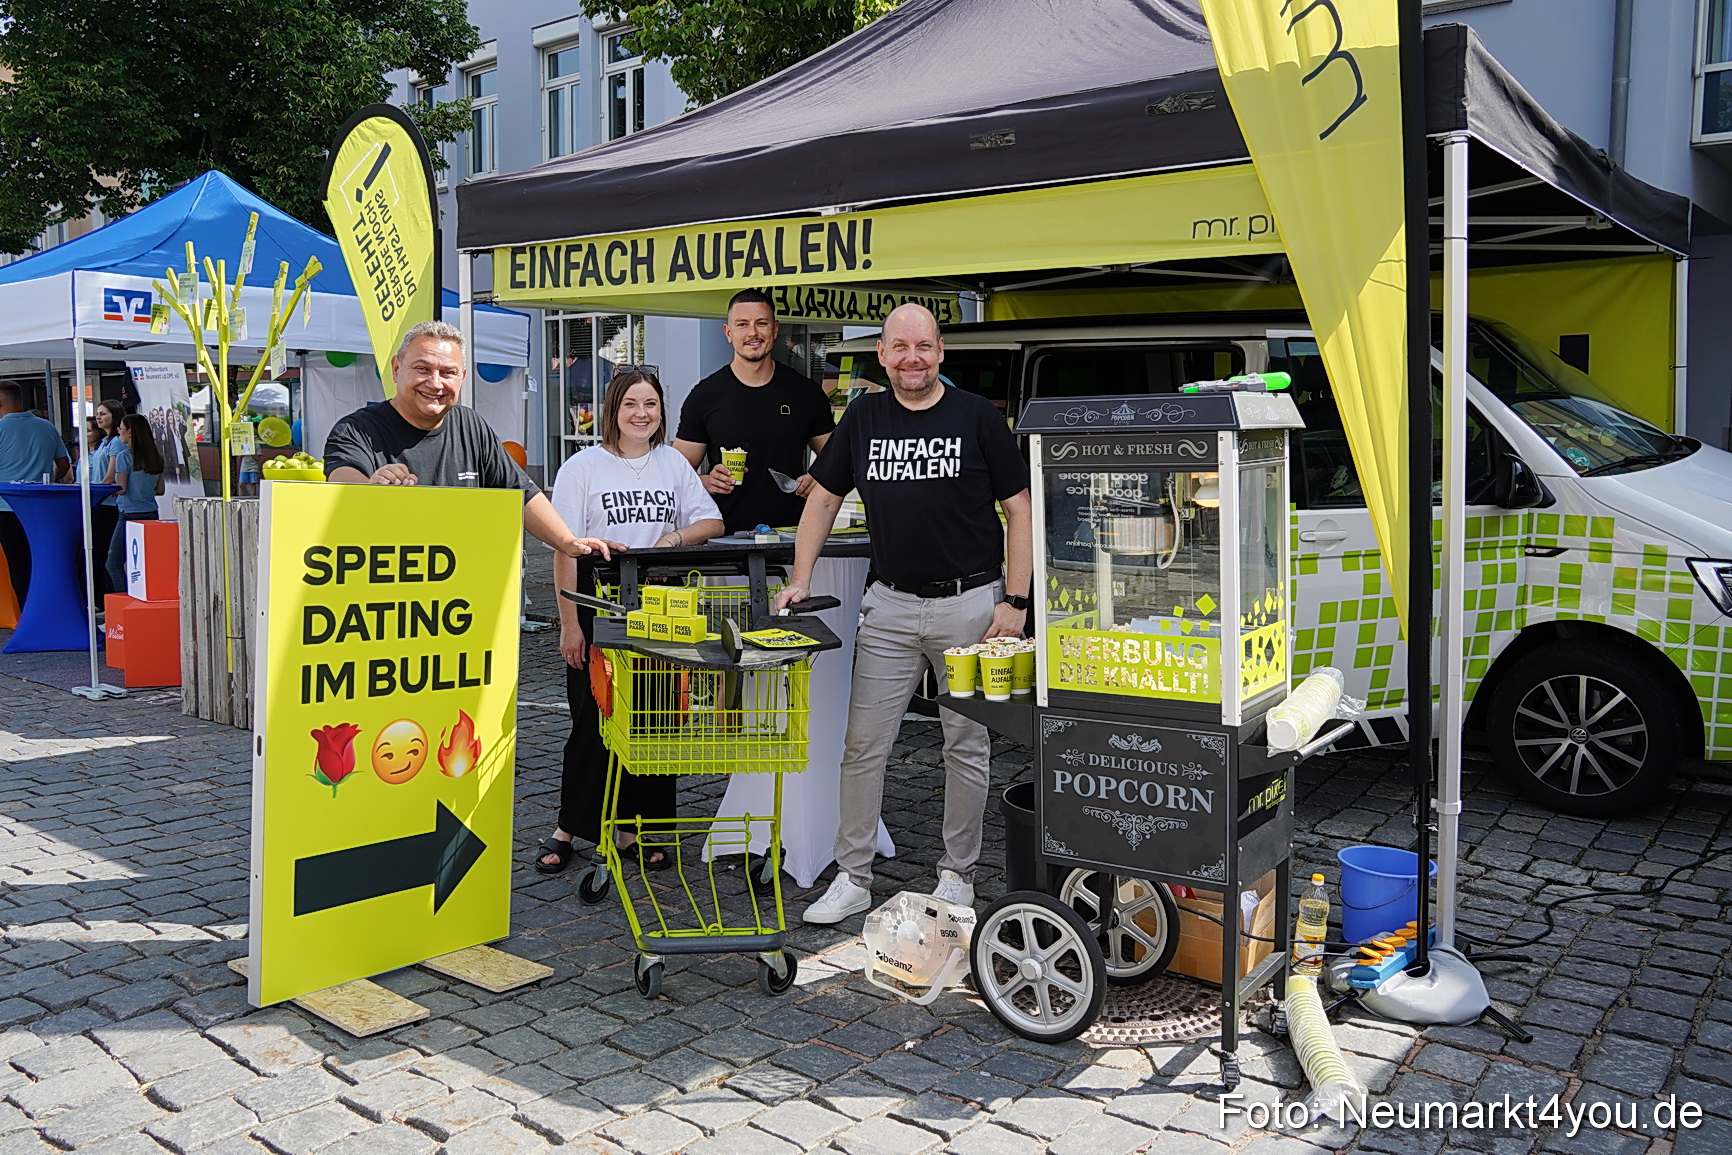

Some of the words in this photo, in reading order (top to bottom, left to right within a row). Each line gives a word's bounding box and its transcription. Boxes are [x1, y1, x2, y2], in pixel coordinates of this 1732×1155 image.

[1192, 216, 1241, 239] mr.
[1248, 214, 1275, 242] pi
[509, 238, 655, 290] EINFACH
[667, 218, 873, 283] AUFALEN!
[869, 437, 962, 460] EINFACH
[1081, 445, 1111, 456] HOT
[1114, 444, 1125, 456] &
[1127, 443, 1174, 456] FRESH
[866, 458, 961, 481] AUFALEN!
[601, 490, 676, 510] EINFACH
[607, 507, 676, 526] AUFALEN!
[302, 545, 456, 586] SPEED
[302, 598, 473, 645] DATING
[652, 622, 667, 630] PIXEL
[675, 624, 691, 632] PIXEL
[1059, 634, 1208, 669] WERBUNG
[301, 661, 355, 704] IM
[368, 650, 492, 697] BULLI
[1059, 662, 1098, 686] DIE
[1103, 666, 1209, 695] KNALLT!
[1088, 753, 1178, 776] DELICIOUS
[1053, 769, 1215, 814] POPCORN
[883, 954, 913, 973] beamZ
